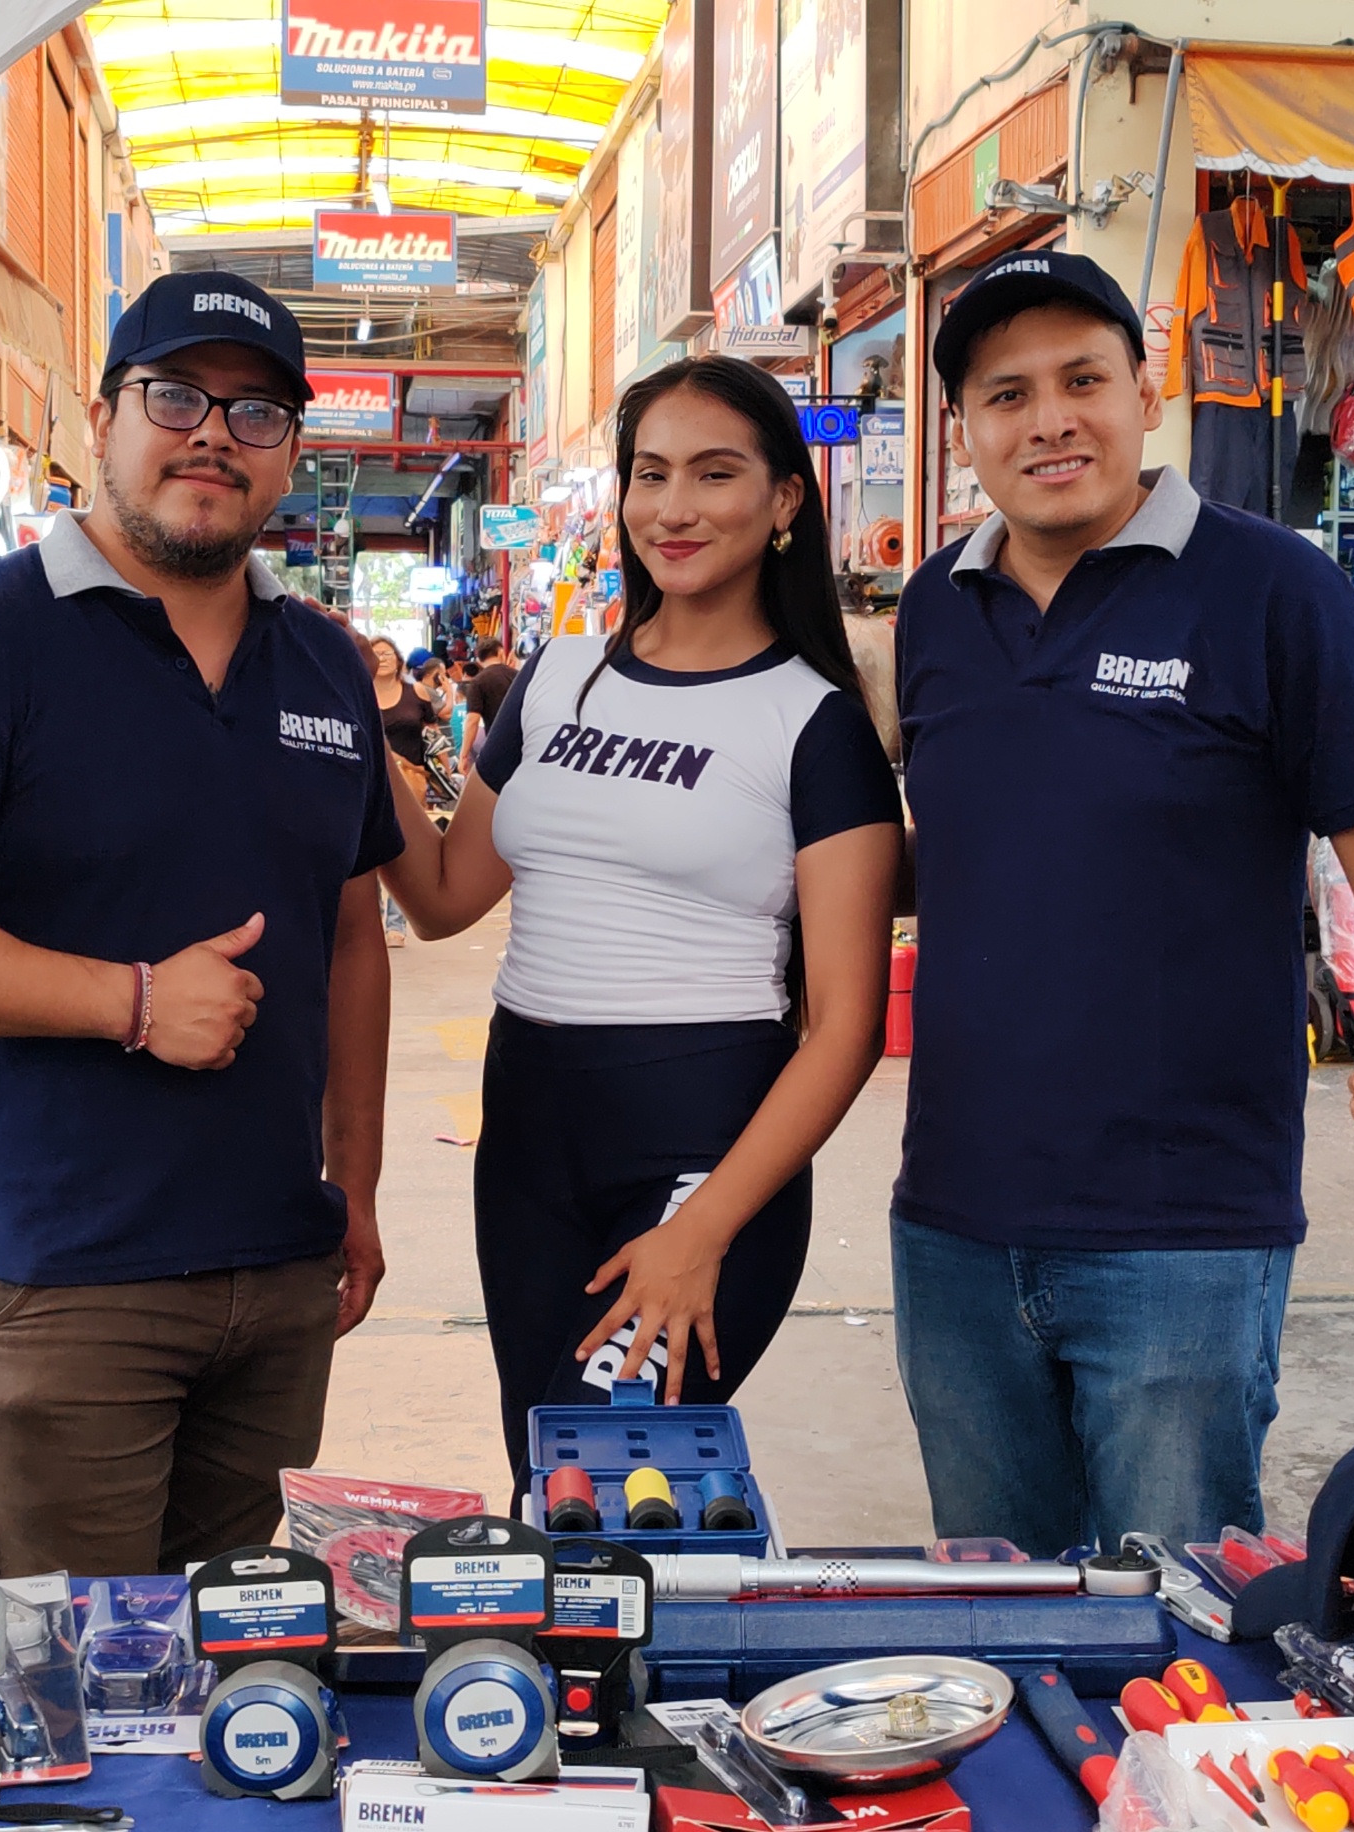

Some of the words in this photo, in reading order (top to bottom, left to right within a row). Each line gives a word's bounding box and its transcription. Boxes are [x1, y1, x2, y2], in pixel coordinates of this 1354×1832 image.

[316, 63, 374, 75] SOLUCIONES
[376, 67, 384, 76] A
[386, 66, 425, 78] BATERÍA
[352, 80, 416, 92] www.makita.pe
[321, 94, 368, 107] PASAJE
[372, 97, 437, 110] PRINCIPAL
[441, 101, 448, 110] 3
[342, 284, 374, 292] PASAJE
[377, 285, 422, 293] PRINCIPAL
[193, 293, 271, 331] BREMEN
[721, 326, 798, 347] Hidrostal
[485, 509, 518, 518] TOTAL
[1096, 652, 1191, 690] BREMEN
[1090, 682, 1140, 698] QUALITÄT
[280, 710, 353, 749] BREMEN
[317, 746, 334, 755] UND
[538, 723, 715, 791] BREMEN
[344, 1491, 419, 1511] WEMBLEY
[455, 1561, 500, 1575] BREMEN
[240, 1588, 283, 1602] BREMEN
[457, 1708, 514, 1732] BREMEN
[235, 1731, 288, 1749] BREMEN
[480, 1737, 497, 1747] 5m
[358, 1803, 424, 1824] BREMEN
